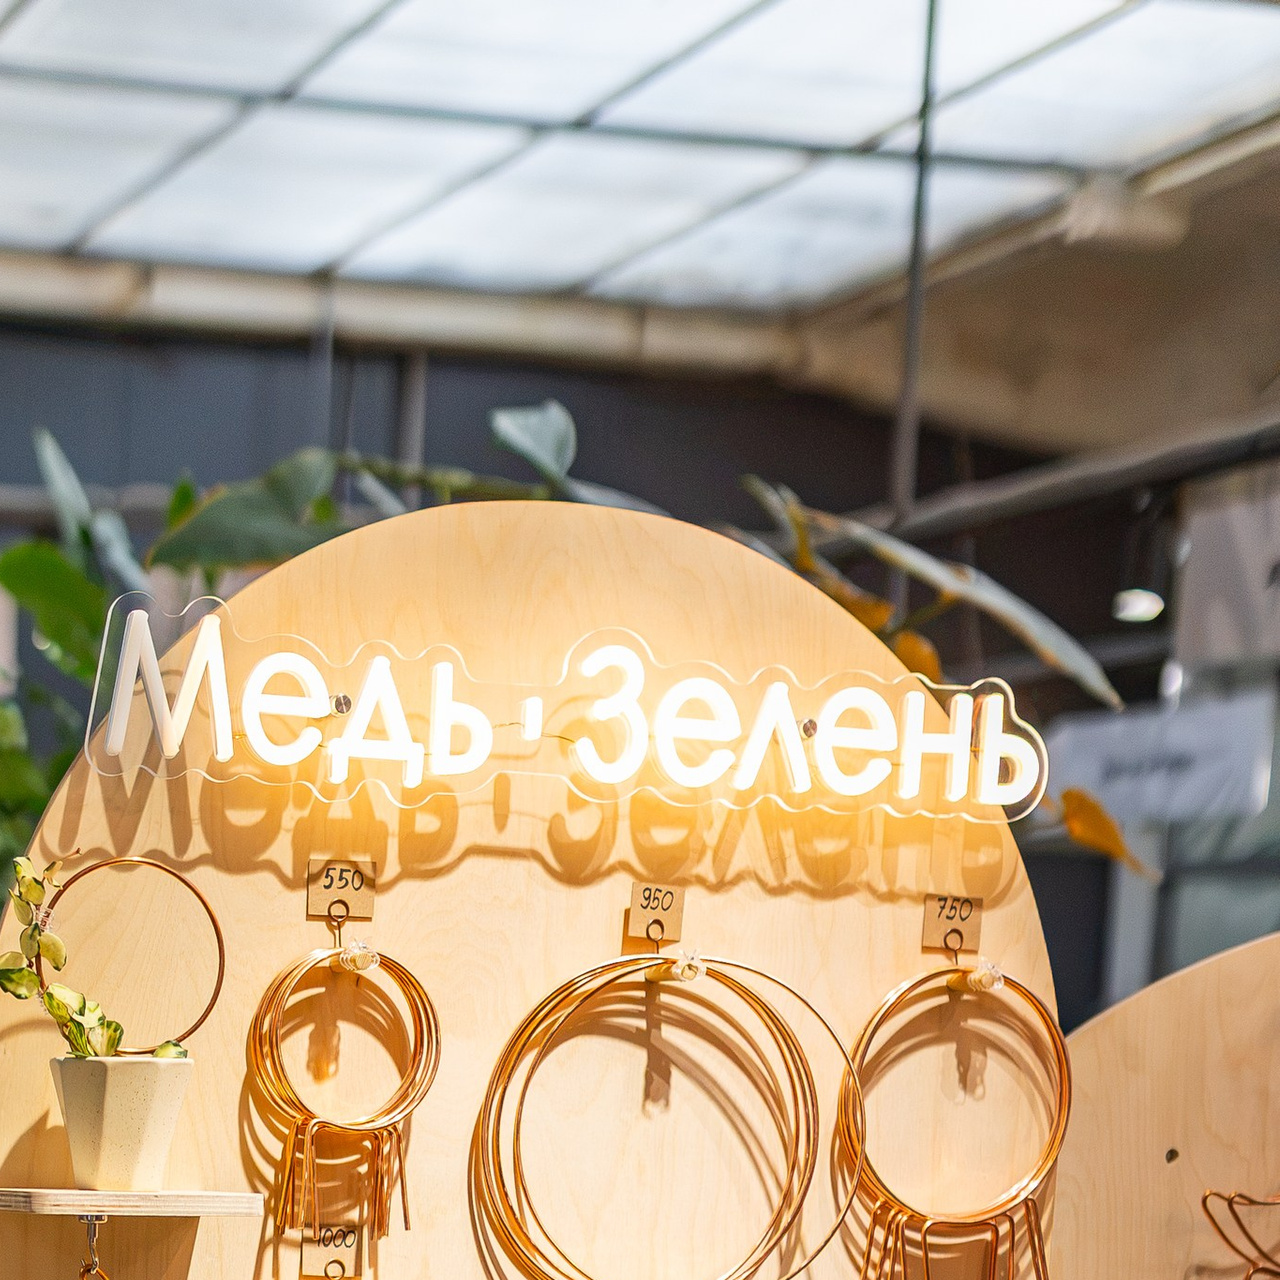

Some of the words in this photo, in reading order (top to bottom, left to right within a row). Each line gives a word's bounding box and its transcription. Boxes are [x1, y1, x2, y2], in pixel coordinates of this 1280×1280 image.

[106, 609, 492, 788] Медь
[573, 646, 1041, 806] Зелень
[323, 866, 364, 892] 550
[640, 886, 674, 912] 950
[937, 895, 973, 922] 750
[317, 1227, 356, 1250] 1000
